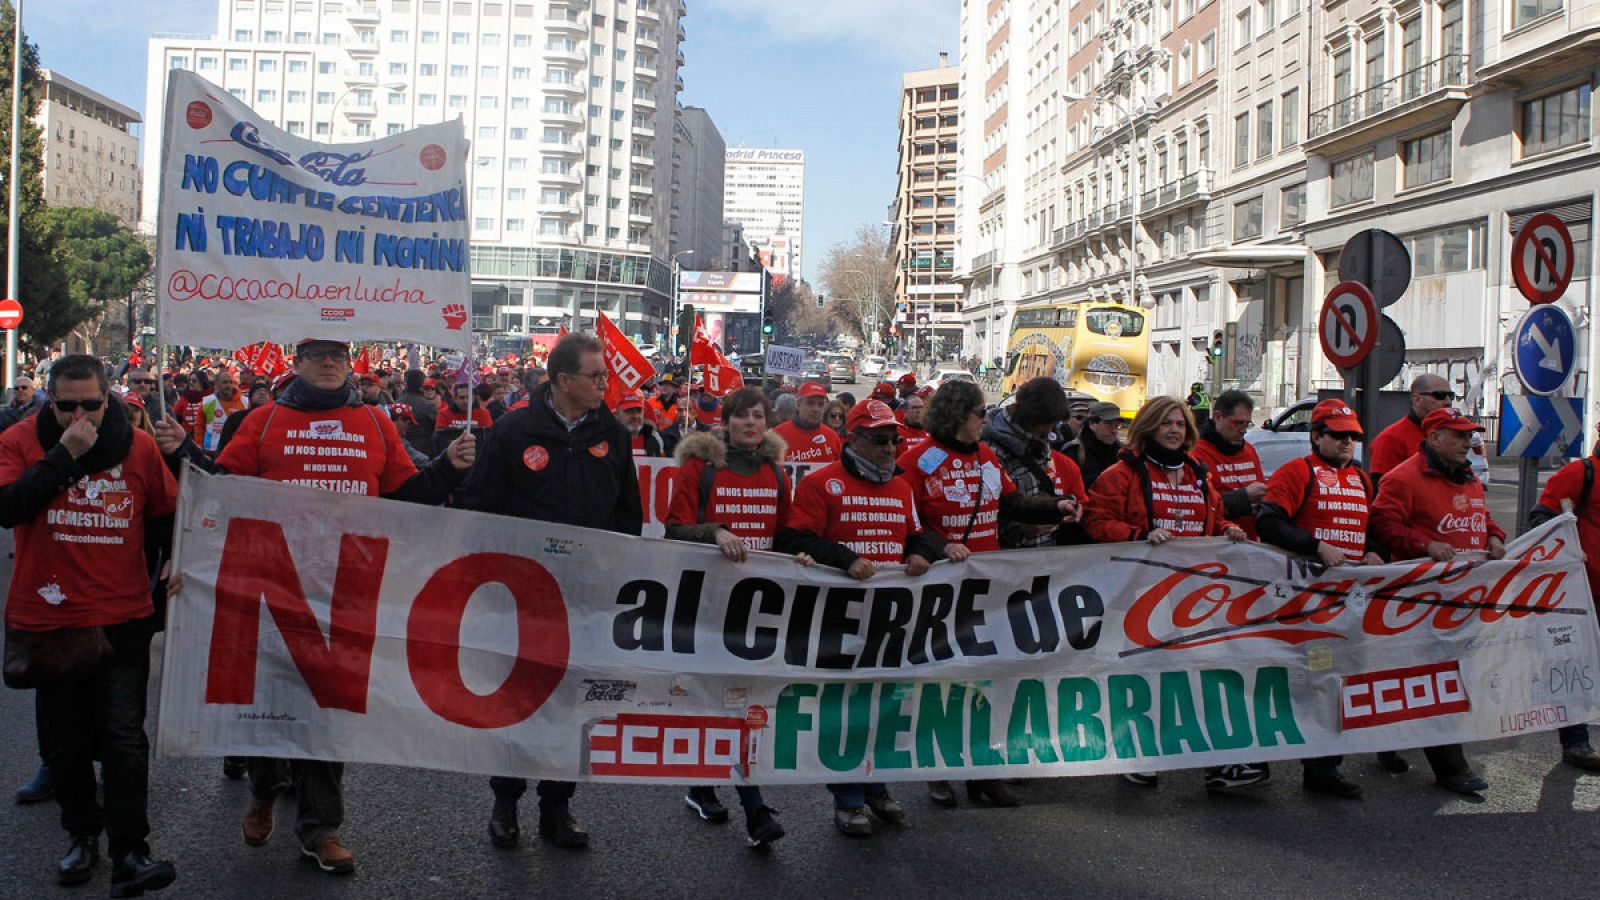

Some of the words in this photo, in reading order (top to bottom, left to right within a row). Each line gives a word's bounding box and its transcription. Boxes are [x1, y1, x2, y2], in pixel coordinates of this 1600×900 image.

[725, 149, 755, 160] adrid
[759, 150, 802, 161] Princesa
[182, 154, 219, 193] NO
[176, 206, 207, 252] NI
[216, 215, 325, 262] TRABAJO
[335, 225, 366, 264] NI
[374, 232, 467, 273] NOMINA
[287, 430, 297, 439] NI
[284, 445, 294, 455] NI
[296, 445, 316, 456] NOS
[318, 446, 367, 459] DOBLARON
[304, 463, 311, 471] NI
[312, 463, 326, 472] NOS
[327, 464, 341, 472] VAN
[342, 464, 348, 472] A
[716, 487, 725, 497] NI
[726, 487, 741, 497] NOS
[842, 495, 851, 505] NI
[852, 496, 868, 505] NOS
[1327, 501, 1342, 510] NOS
[716, 504, 725, 513] NI
[725, 504, 741, 513] NOS
[840, 512, 849, 522] NI
[851, 512, 867, 522] NOS
[838, 540, 904, 554] OMESTICAR
[205, 517, 570, 730] NO
[612, 570, 706, 654] al
[722, 576, 998, 670] CIERRE
[1006, 575, 1105, 654] de
[1343, 670, 1464, 719] CCOO
[773, 666, 1305, 773] FUENLABRADA
[1500, 705, 1569, 733] LUCHANDO
